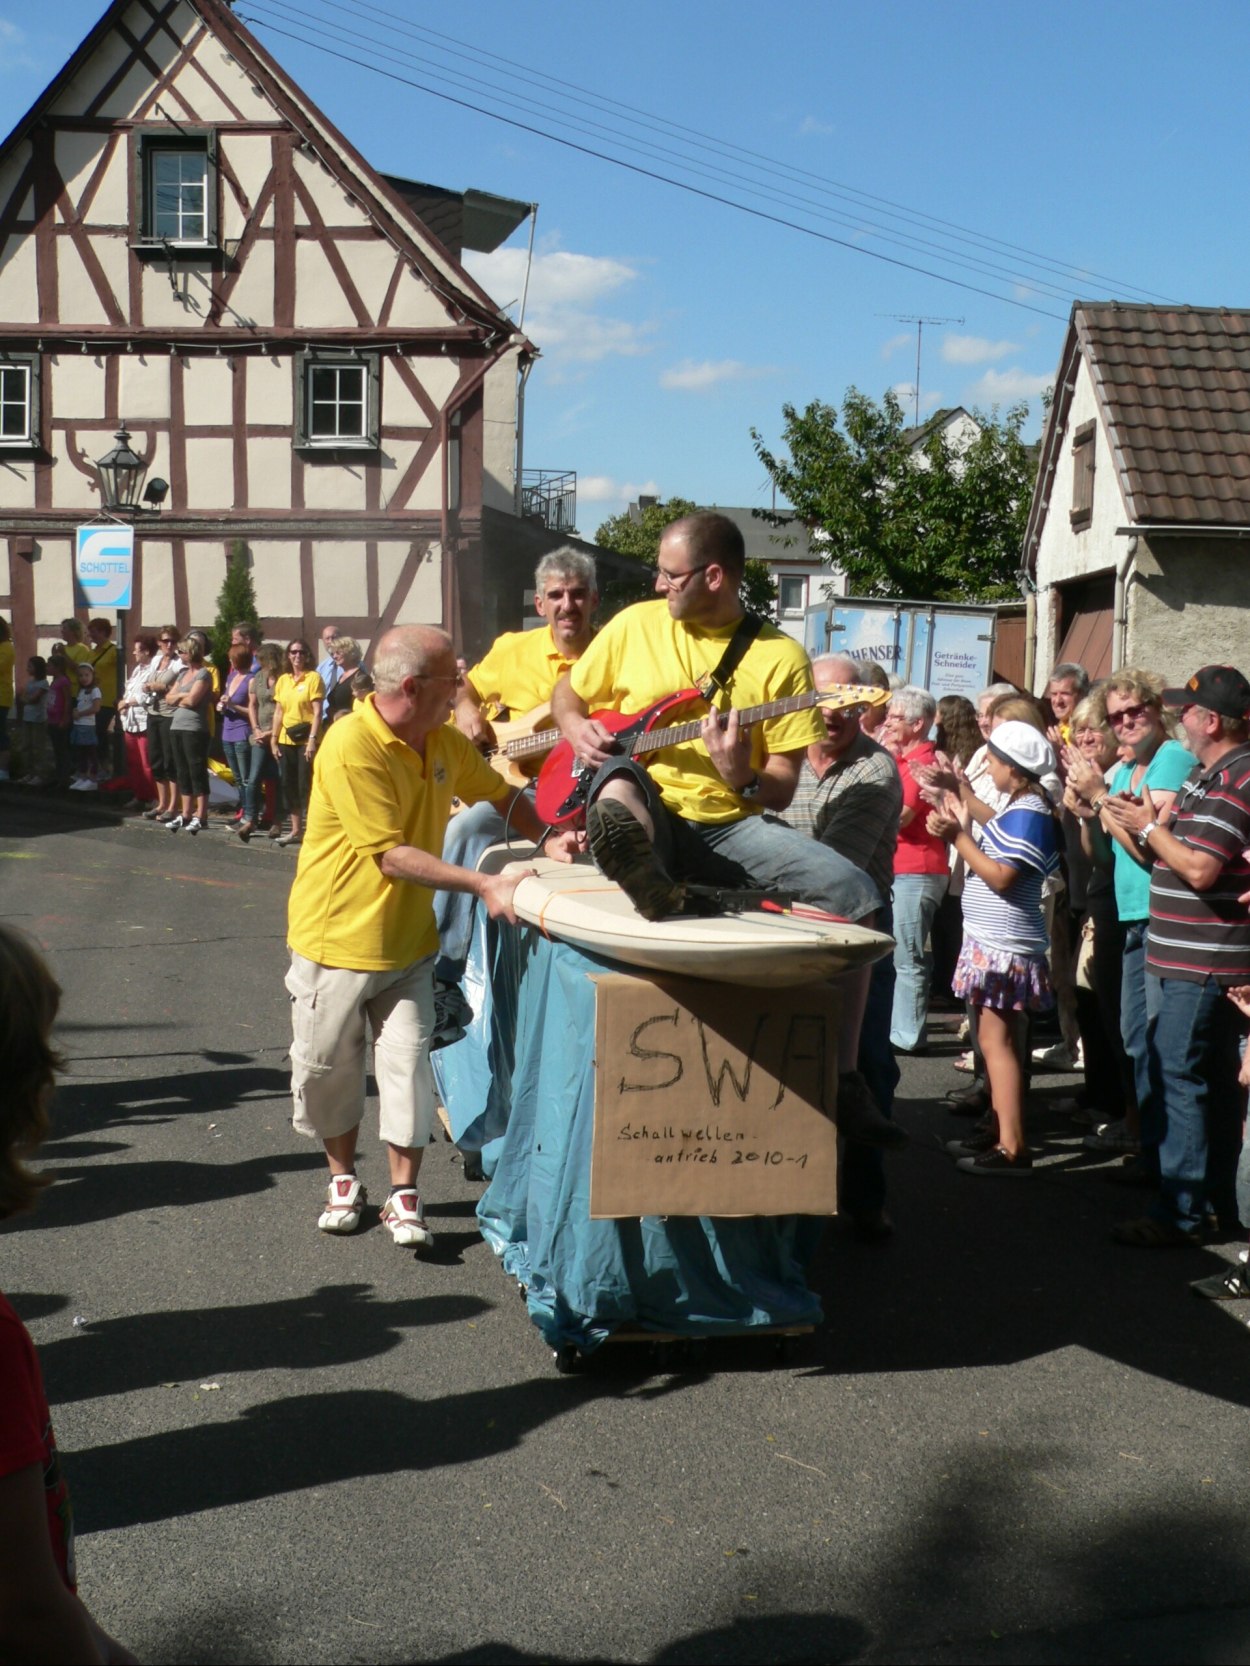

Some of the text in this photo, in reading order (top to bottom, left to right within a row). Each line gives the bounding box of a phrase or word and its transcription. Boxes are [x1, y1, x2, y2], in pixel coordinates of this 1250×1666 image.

[80, 562, 130, 573] SCHOTTEL
[934, 651, 978, 661] Getränke-
[934, 659, 977, 669] Schneider
[617, 1008, 828, 1116] SWA
[654, 1148, 808, 1168] antrieb 2010-1
